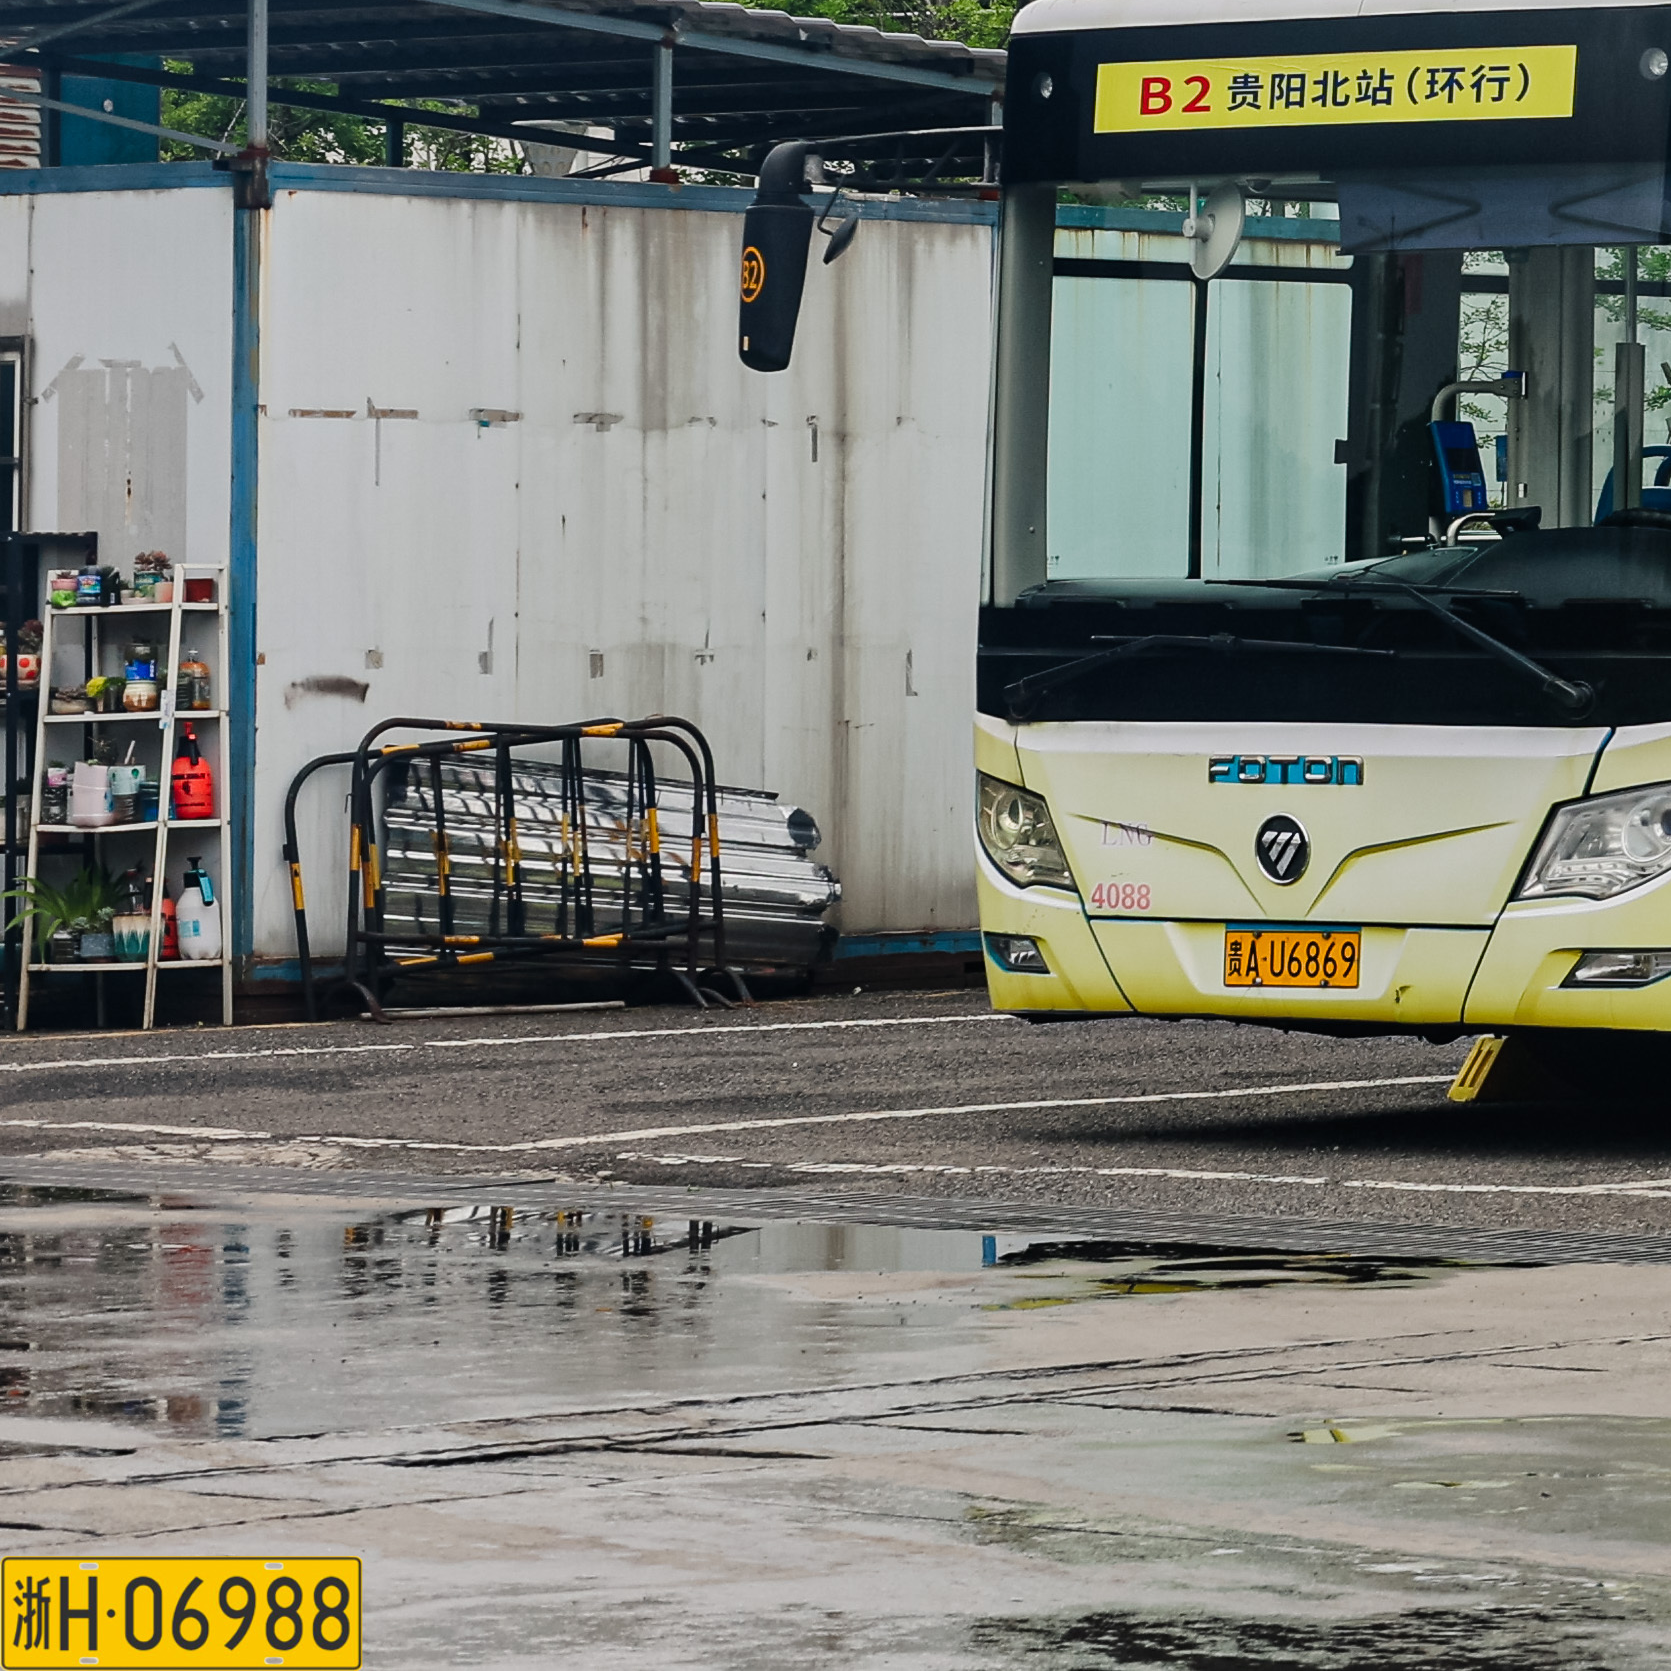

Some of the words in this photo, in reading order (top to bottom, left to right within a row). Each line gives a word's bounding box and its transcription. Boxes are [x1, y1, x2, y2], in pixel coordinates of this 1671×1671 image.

[1139, 75, 1212, 115] B2
[1226, 62, 1532, 112] 贵阳北站（环行）
[742, 260, 759, 290] B2
[1208, 755, 1364, 785] FOTON
[1102, 821, 1152, 847] LNG
[1091, 882, 1151, 910] 4088
